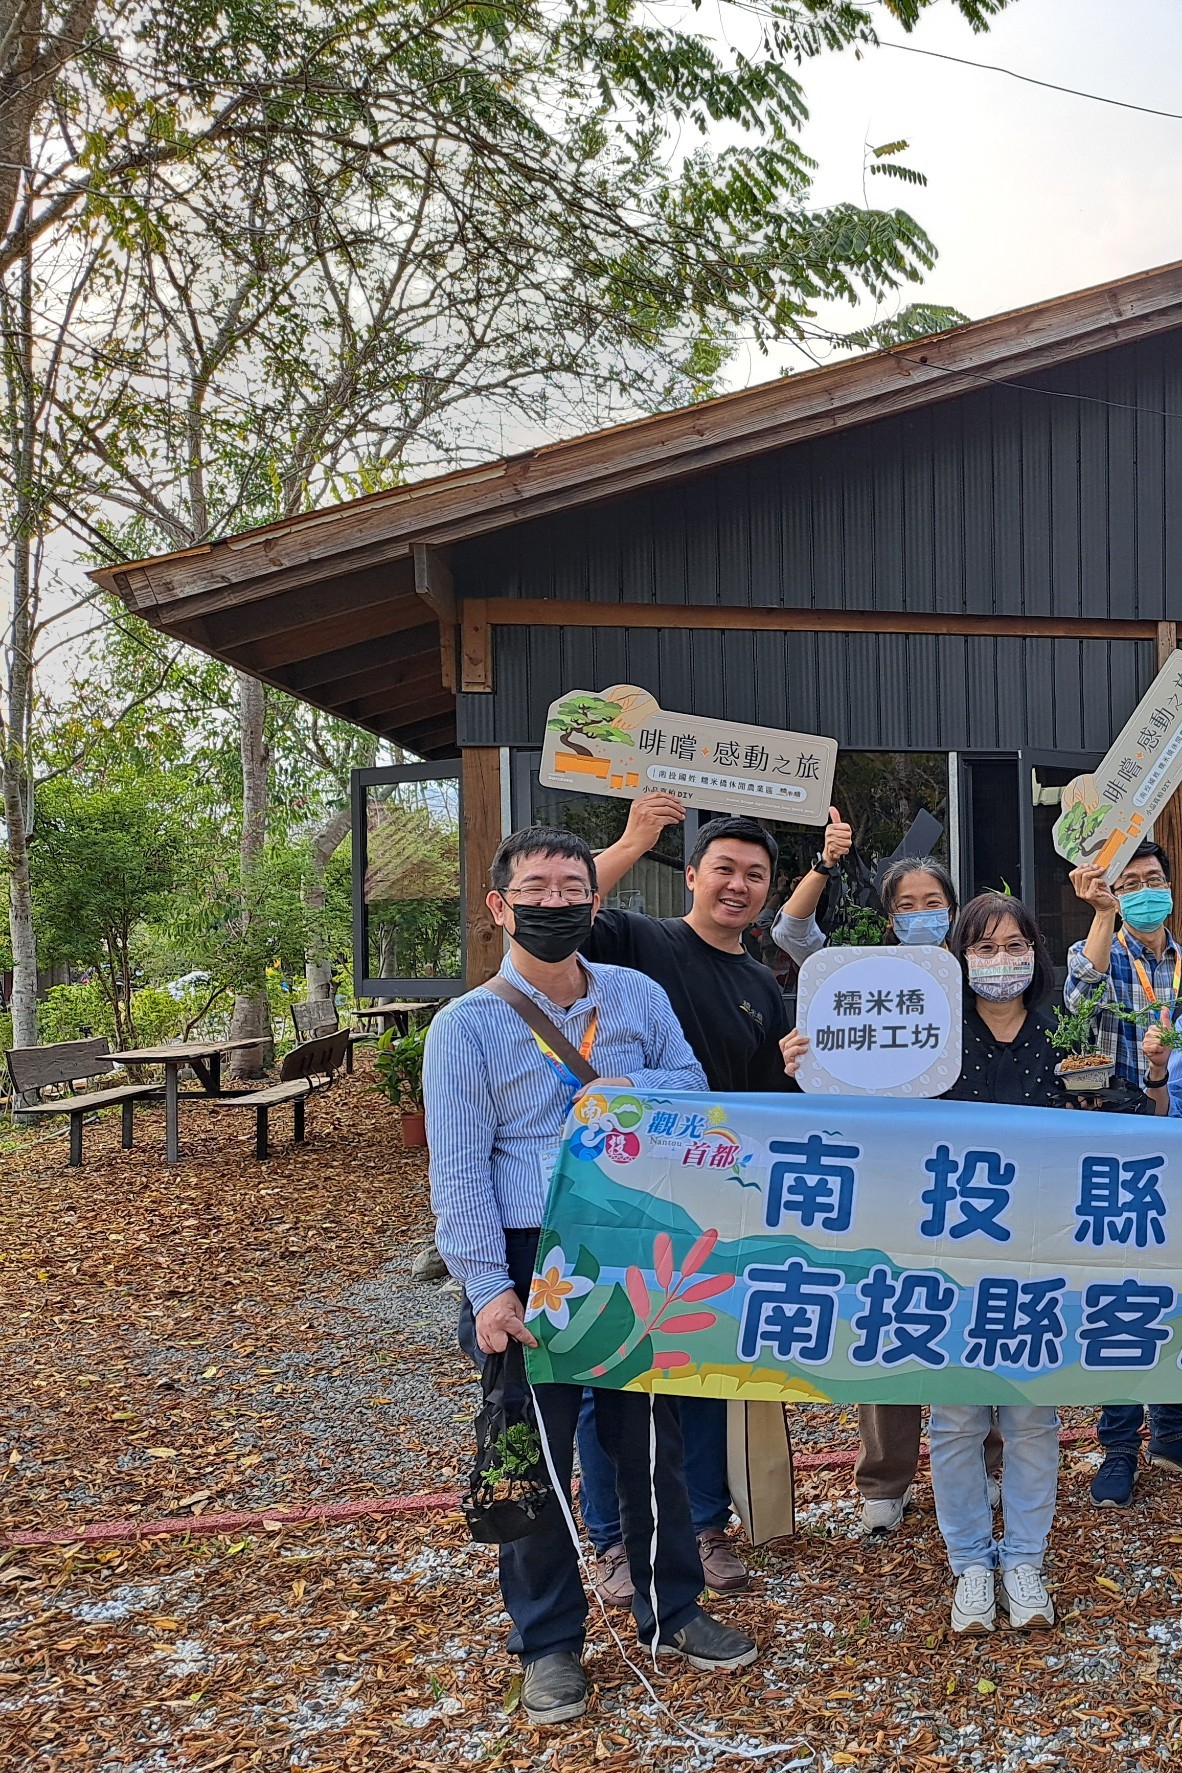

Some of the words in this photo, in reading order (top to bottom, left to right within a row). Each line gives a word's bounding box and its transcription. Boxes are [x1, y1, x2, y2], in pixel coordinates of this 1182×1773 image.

[638, 728, 698, 762] 啡嚐
[712, 740, 822, 781] 感動之旅
[832, 988, 925, 1016] 糯米橋
[815, 1023, 941, 1051] 咖啡工坊
[646, 1110, 706, 1139] 觀光
[649, 1136, 683, 1147] Nantou
[682, 1140, 742, 1168] 首都
